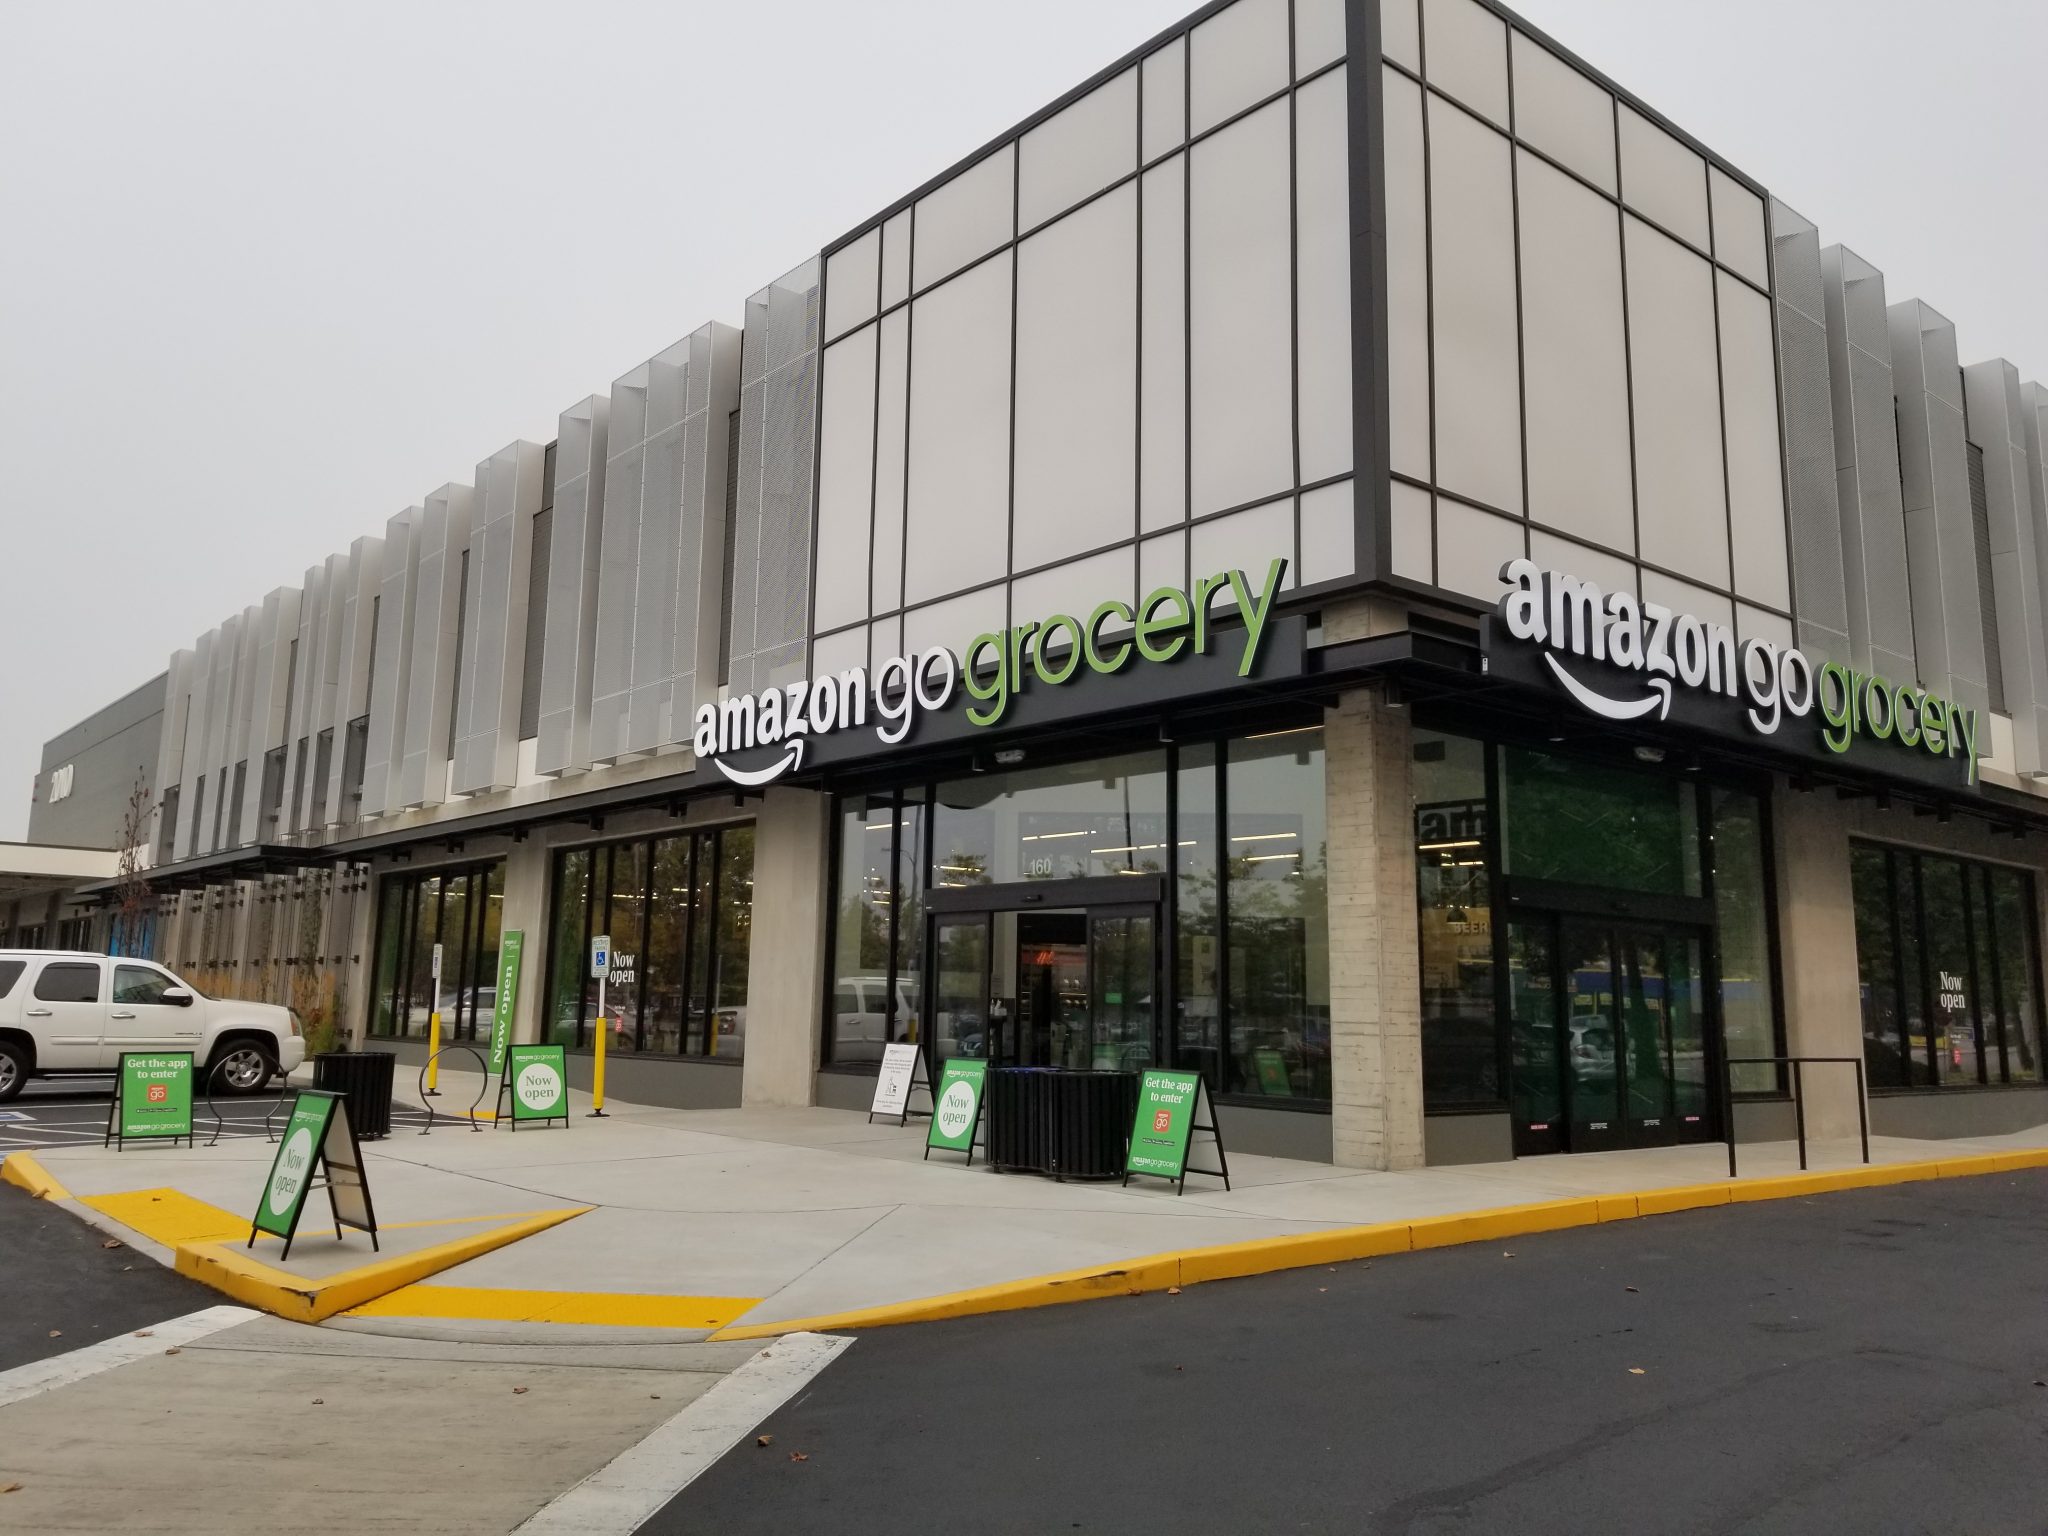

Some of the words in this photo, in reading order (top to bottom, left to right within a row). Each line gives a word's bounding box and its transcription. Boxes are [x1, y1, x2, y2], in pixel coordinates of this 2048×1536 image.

[694, 666, 866, 760] amazon
[876, 647, 958, 743] go
[965, 557, 1289, 726] grocery
[1499, 559, 1739, 699] amazon
[1741, 637, 1813, 734] go
[1814, 661, 1977, 785] grocery
[1029, 858, 1051, 875] 160
[612, 951, 635, 968] Now
[610, 969, 635, 987] open
[1940, 971, 1962, 990] Now
[1941, 993, 1965, 1013] open
[493, 1020, 506, 1063] Now
[501, 965, 513, 1015] open
[127, 1058, 146, 1068] Get
[148, 1058, 166, 1068] the
[167, 1059, 188, 1069] app
[137, 1070, 148, 1079] to
[150, 1070, 178, 1079] enter
[526, 1075, 552, 1087] Now
[1145, 1077, 1160, 1088] Get
[1161, 1078, 1175, 1089] the
[1176, 1082, 1193, 1094] app
[150, 1090, 165, 1101] go
[525, 1088, 554, 1101] open
[946, 1094, 969, 1109] Now
[1150, 1091, 1159, 1101] to
[1160, 1093, 1183, 1104] enter
[942, 1111, 966, 1125] open
[1156, 1118, 1168, 1129] go
[283, 1148, 305, 1170] Now
[275, 1175, 297, 1196] open
